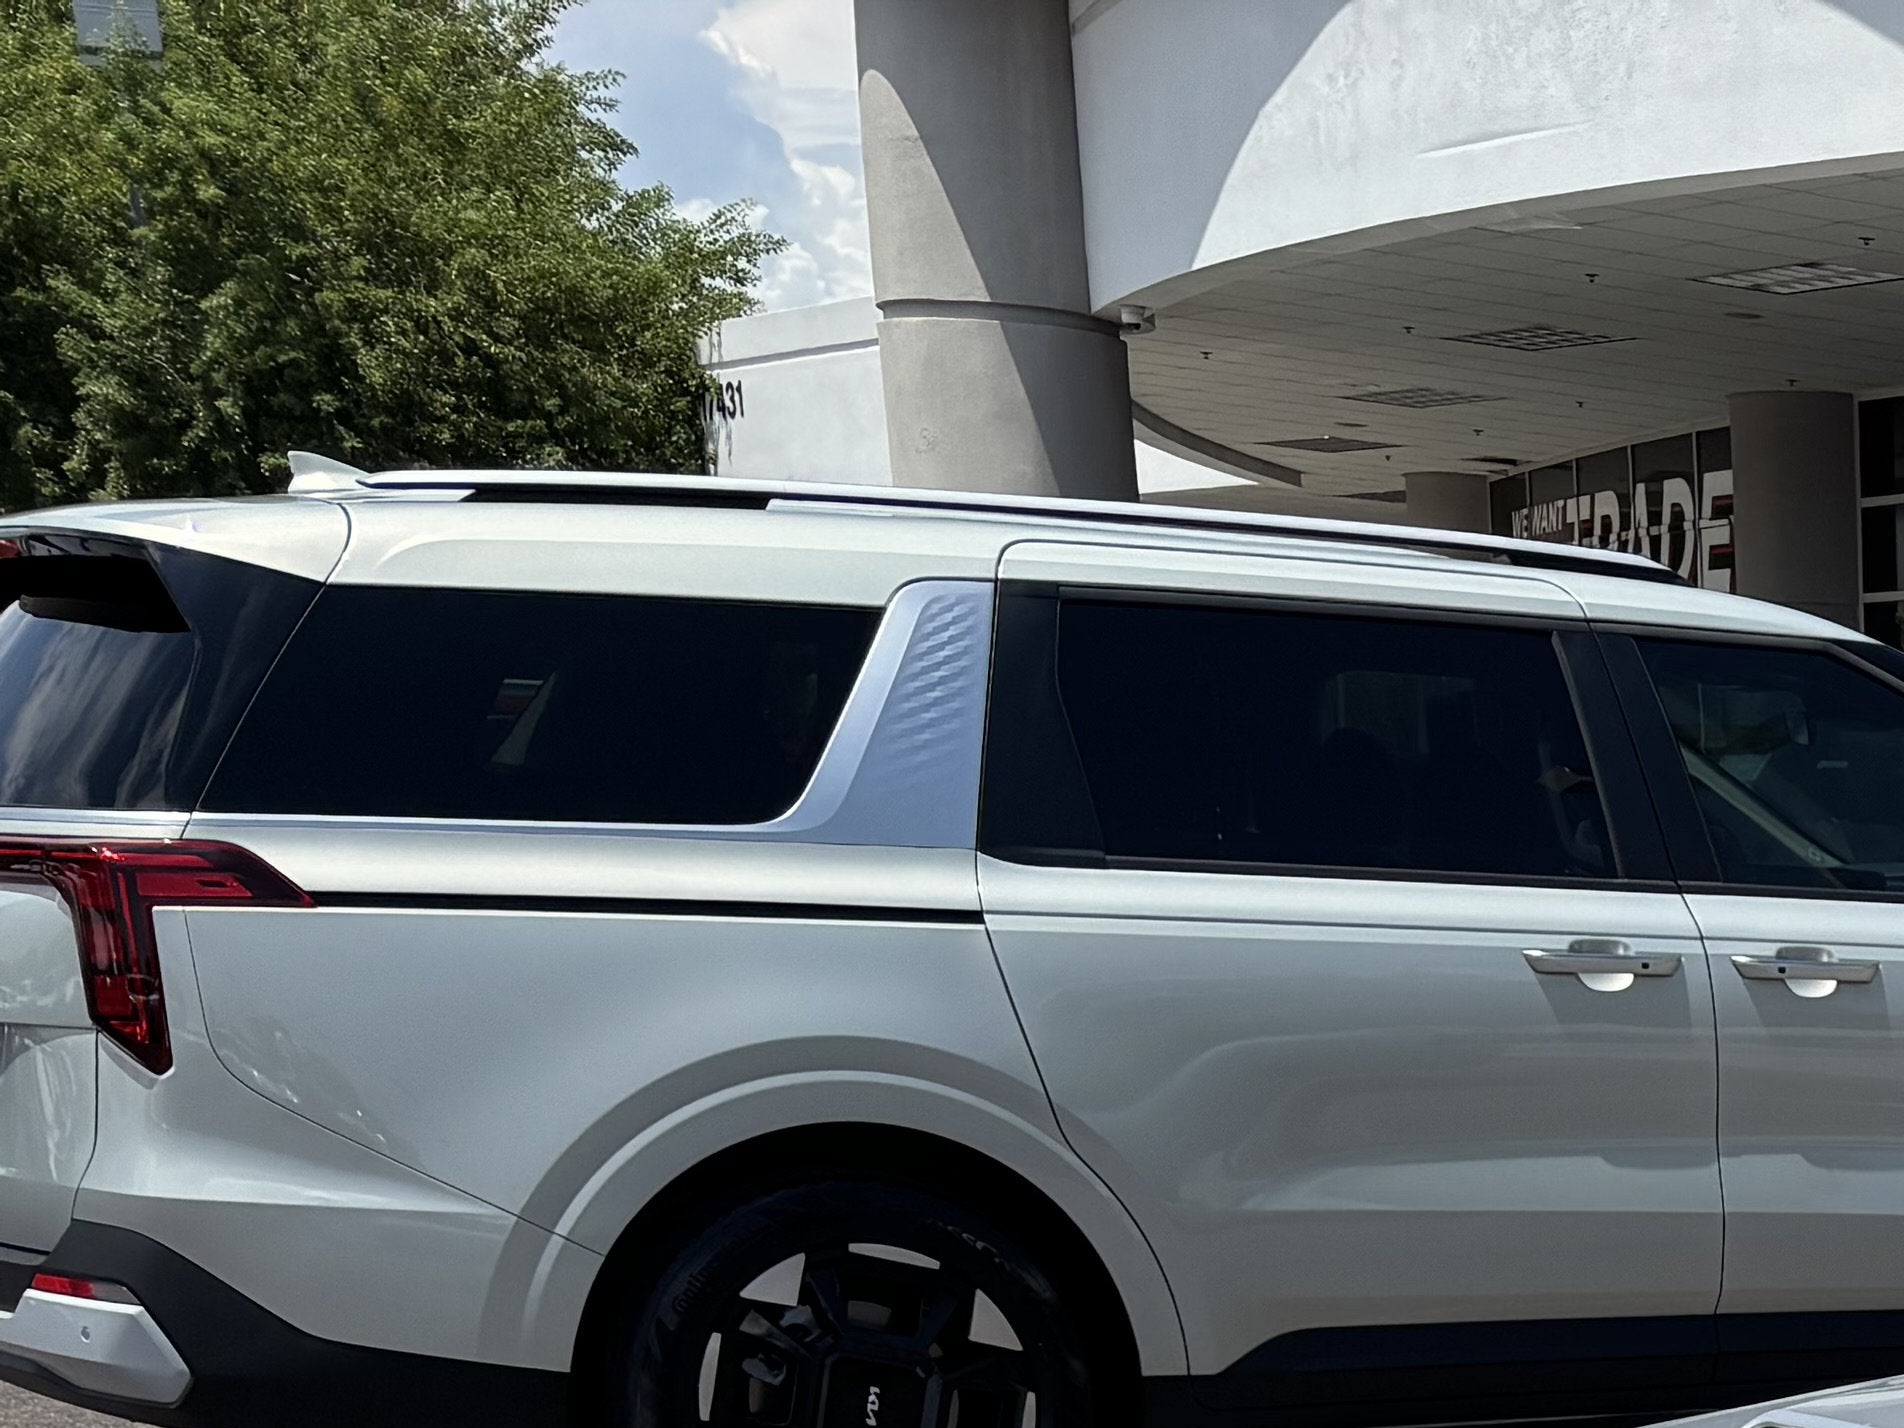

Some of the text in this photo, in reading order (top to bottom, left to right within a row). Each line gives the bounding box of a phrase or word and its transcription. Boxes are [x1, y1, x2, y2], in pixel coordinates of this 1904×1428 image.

[1511, 469, 1734, 593] WE WANT TRADE
